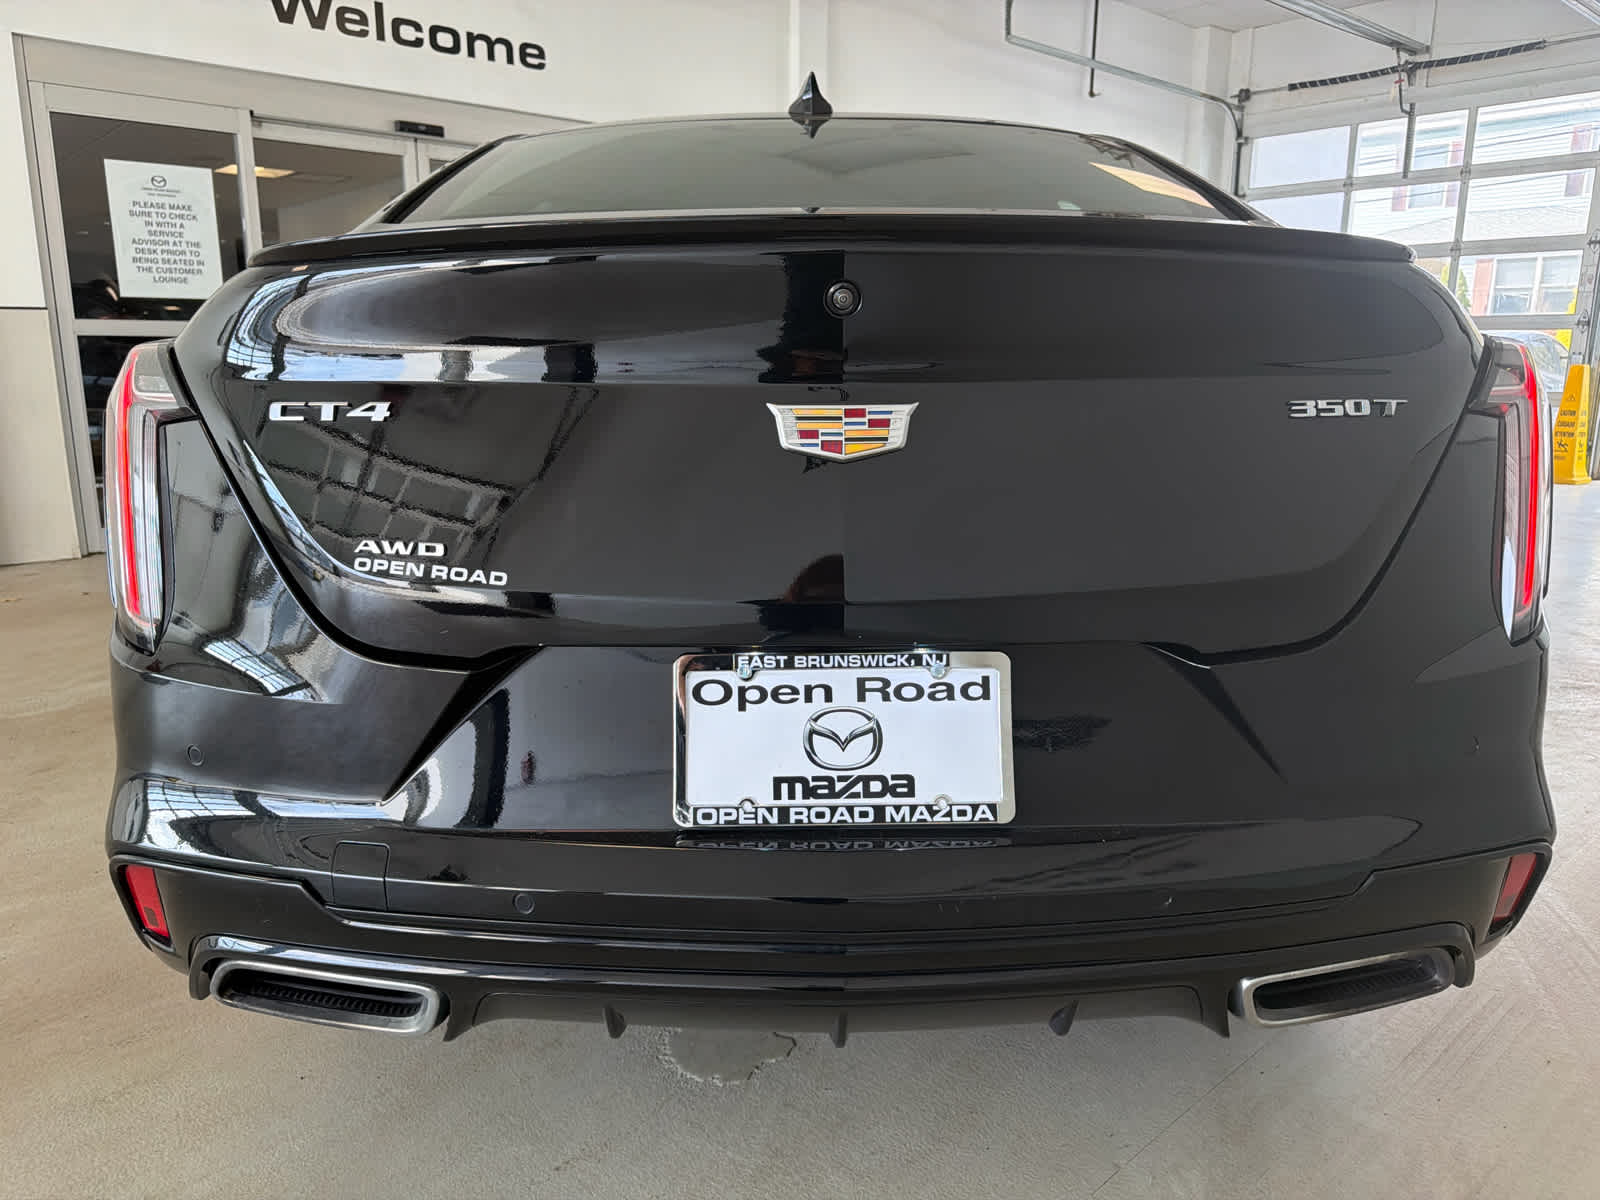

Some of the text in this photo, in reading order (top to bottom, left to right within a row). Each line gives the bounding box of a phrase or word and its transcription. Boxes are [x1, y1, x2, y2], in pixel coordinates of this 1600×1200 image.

[271, 0, 546, 70] Welcome
[132, 200, 192, 212] PLEASE MAKE
[129, 209, 198, 222] SURE TO CHECK
[155, 220, 177, 229] WITH
[147, 229, 184, 239] SERVICE
[131, 237, 201, 249] ADVISOR AT THE
[135, 247, 200, 258] DESK PRIOR TO
[132, 256, 159, 265] BEING
[161, 257, 195, 266] SEATED
[136, 265, 203, 276] THE CUSTOMER
[153, 275, 188, 285] LOUNGE
[269, 401, 391, 421] CT4
[1288, 399, 1408, 417] 350T
[354, 539, 445, 557] AWD
[353, 557, 508, 586] OPEN ROAD
[737, 654, 947, 668] EAST BRUNSWICK, NJ
[692, 676, 991, 712] Open Road
[696, 804, 994, 824] OPEN ROAD MAZDA
